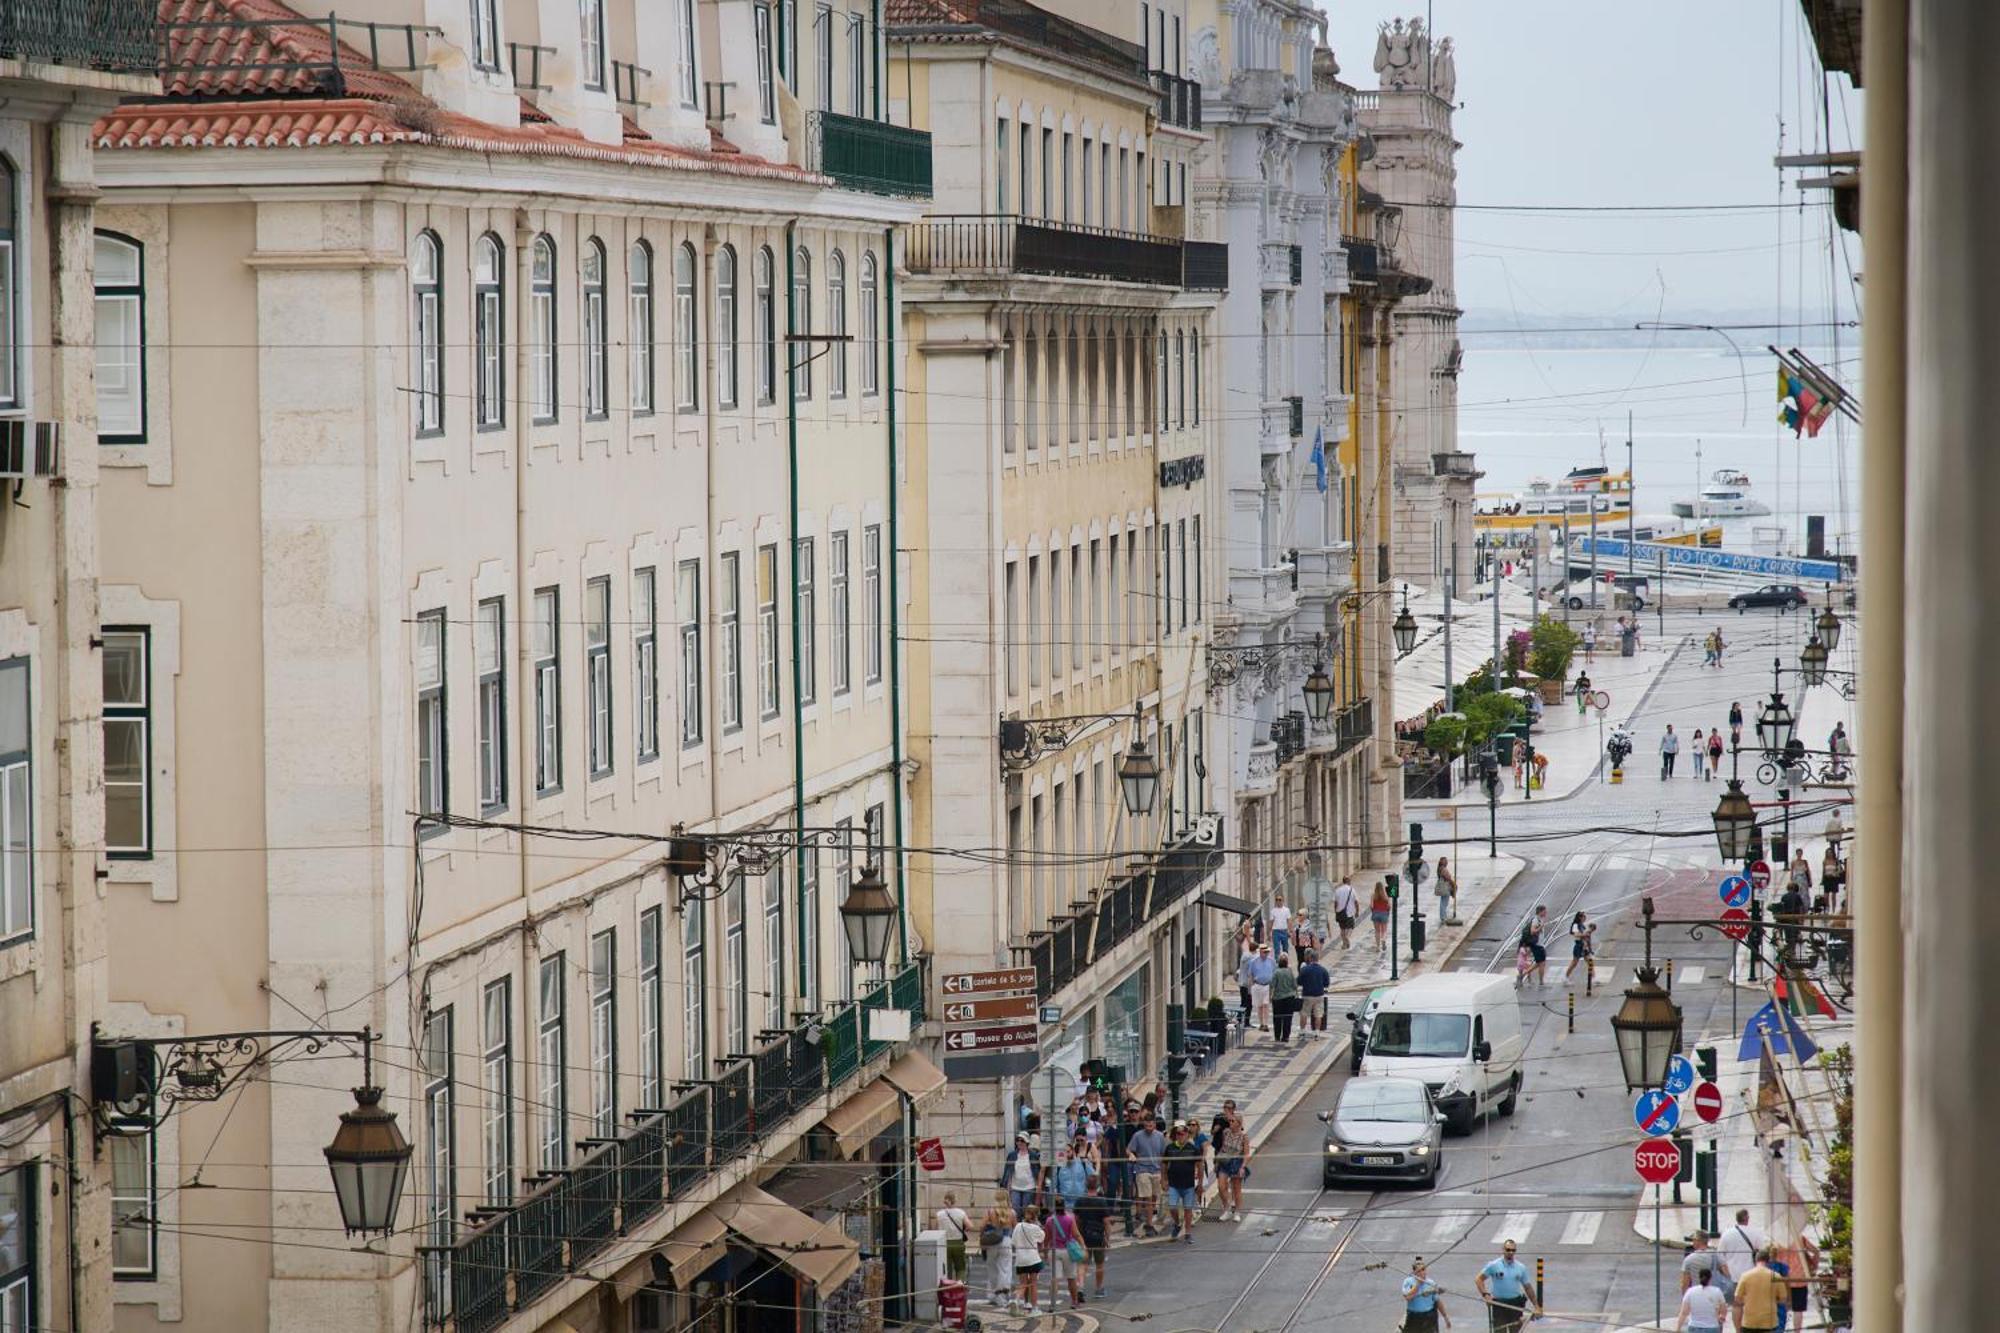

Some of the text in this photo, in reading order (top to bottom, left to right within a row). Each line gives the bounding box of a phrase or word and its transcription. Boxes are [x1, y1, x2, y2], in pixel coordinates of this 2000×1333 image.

[1695, 551, 1721, 566] TEJO
[1732, 556, 1761, 572] RIVER
[1763, 559, 1803, 576] CRUISES
[1000, 975, 1008, 984] de
[976, 1034, 1000, 1043] museu
[1003, 1032, 1013, 1041] do
[1636, 1152, 1679, 1169] STOP
